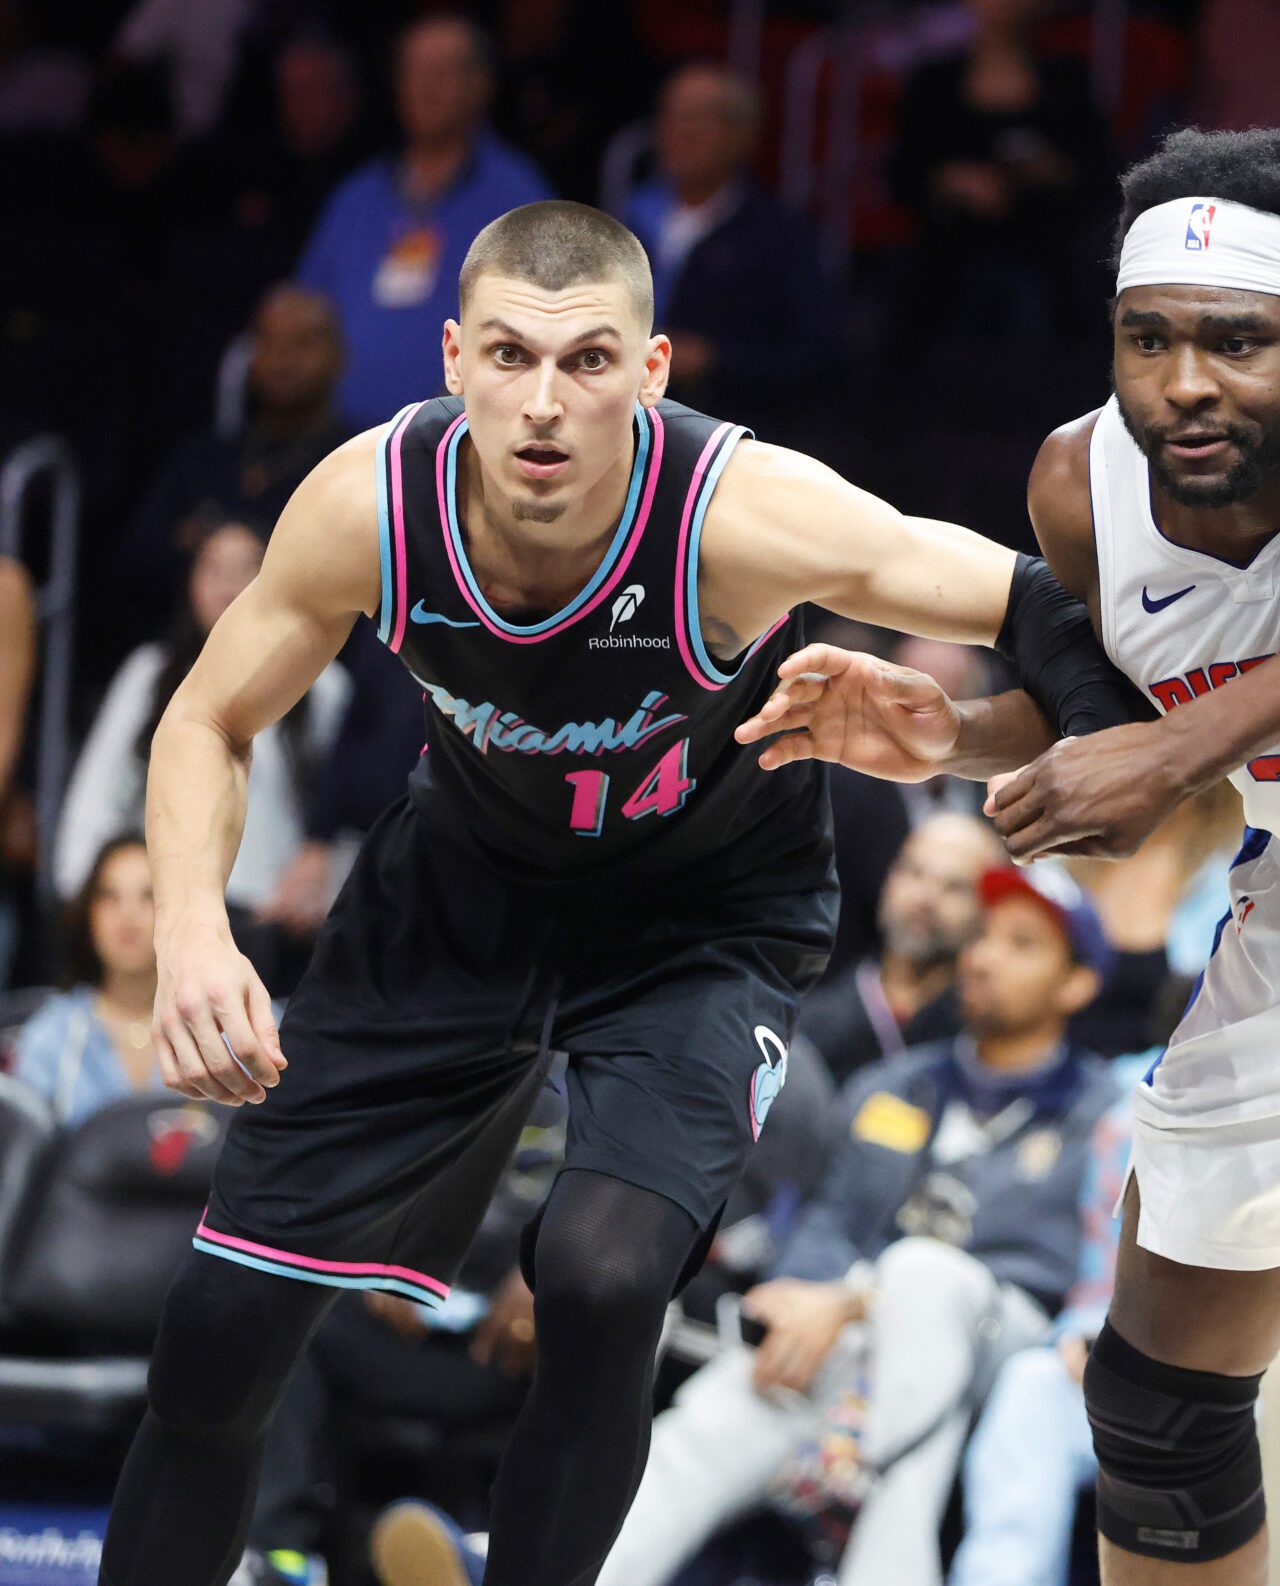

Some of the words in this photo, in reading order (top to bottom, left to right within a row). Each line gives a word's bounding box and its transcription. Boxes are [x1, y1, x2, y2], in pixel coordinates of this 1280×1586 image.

[588, 634, 670, 650] Robinhood
[410, 670, 688, 756] Miami
[564, 738, 697, 837] 14
